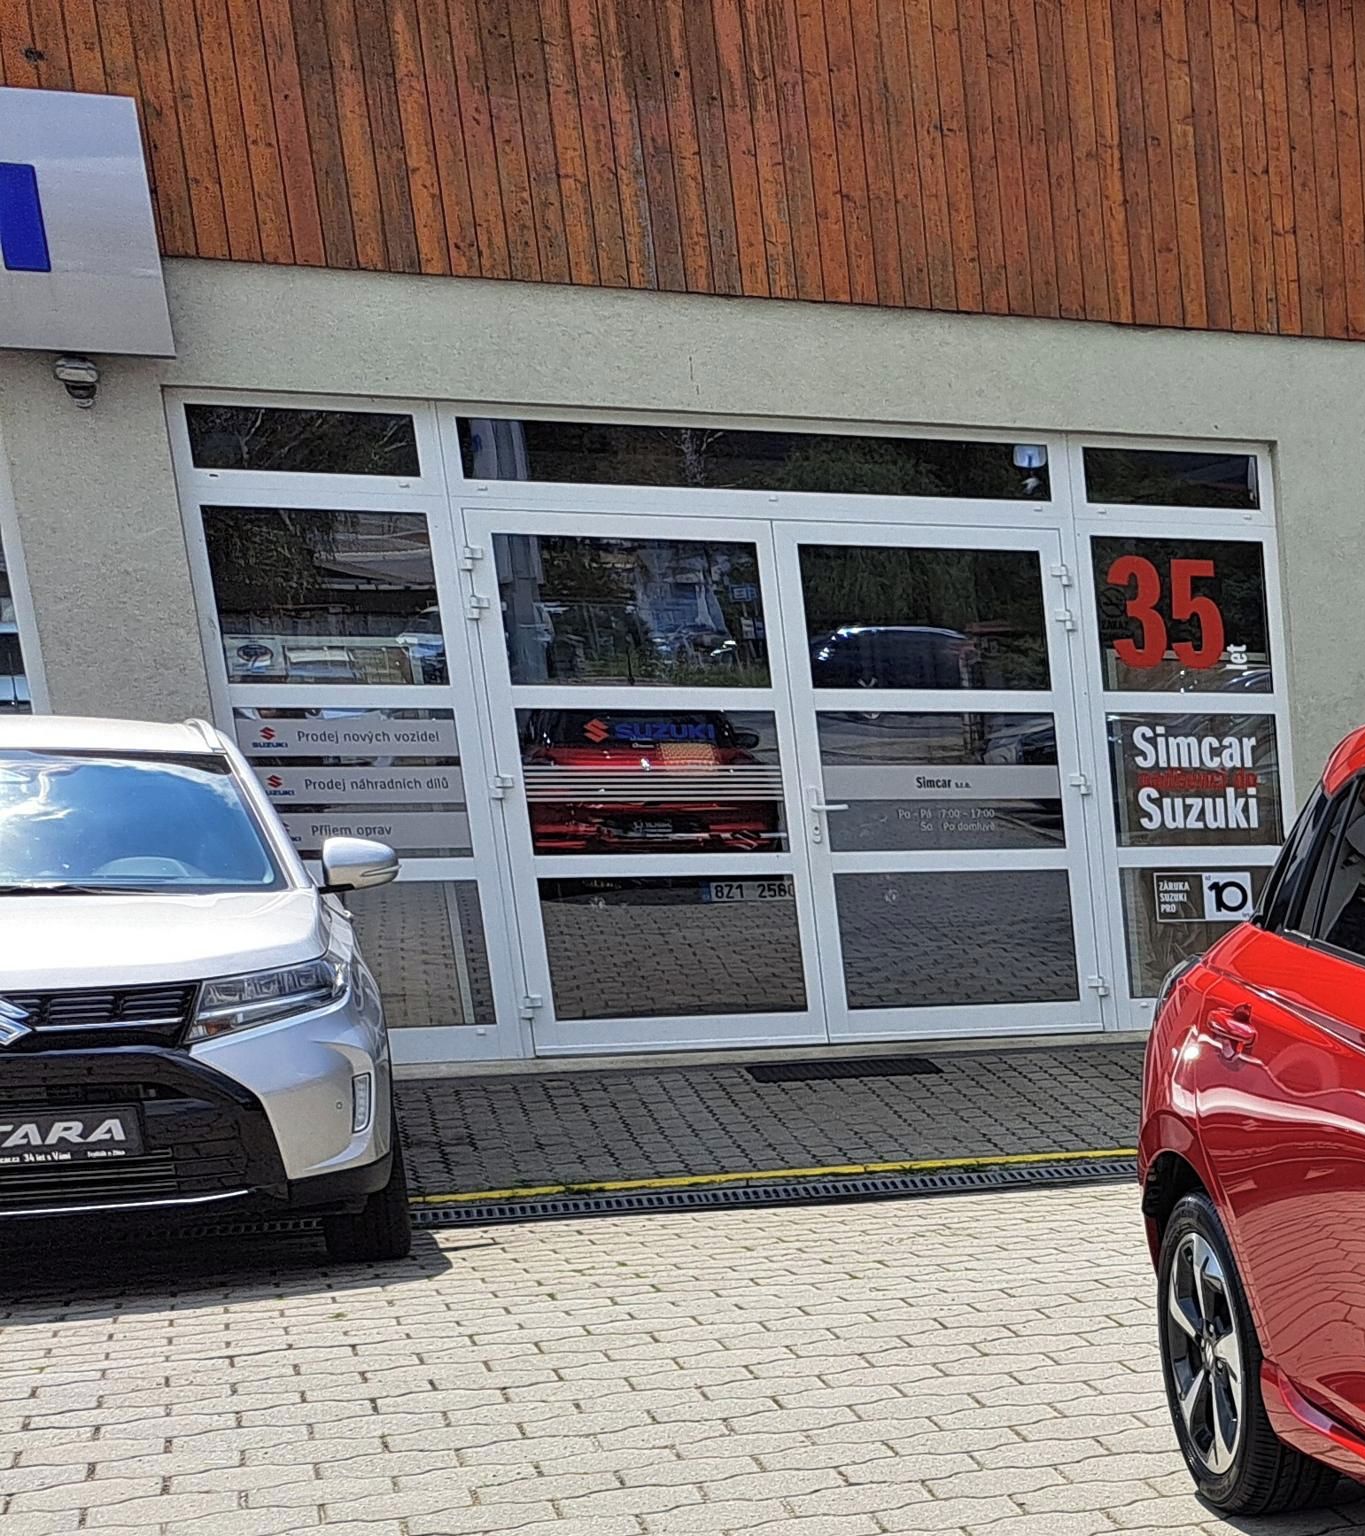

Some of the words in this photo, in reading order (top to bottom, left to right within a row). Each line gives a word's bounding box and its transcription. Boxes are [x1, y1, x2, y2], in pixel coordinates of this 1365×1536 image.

[1106, 555, 1225, 670] 35
[1225, 643, 1248, 670] let
[297, 731, 339, 744] Prodej
[343, 731, 391, 744] nových
[394, 730, 439, 742] vozidel
[614, 722, 715, 740] SUZUKI
[1132, 725, 1257, 768] Simcar
[304, 778, 346, 792] Prodej
[350, 778, 422, 790] náhradních
[426, 777, 449, 789] dílů
[915, 776, 952, 789] Simcar
[970, 808, 995, 819] 17:00
[1137, 786, 1259, 829] Suzuki
[311, 825, 351, 837] Příjem
[356, 827, 392, 837] oprav
[714, 883, 744, 899] 8Z1
[1159, 880, 1190, 891] ZÁRUKA
[1159, 892, 1187, 903] SUZUKI
[1208, 881, 1248, 912] 10
[1160, 903, 1177, 913] PRO
